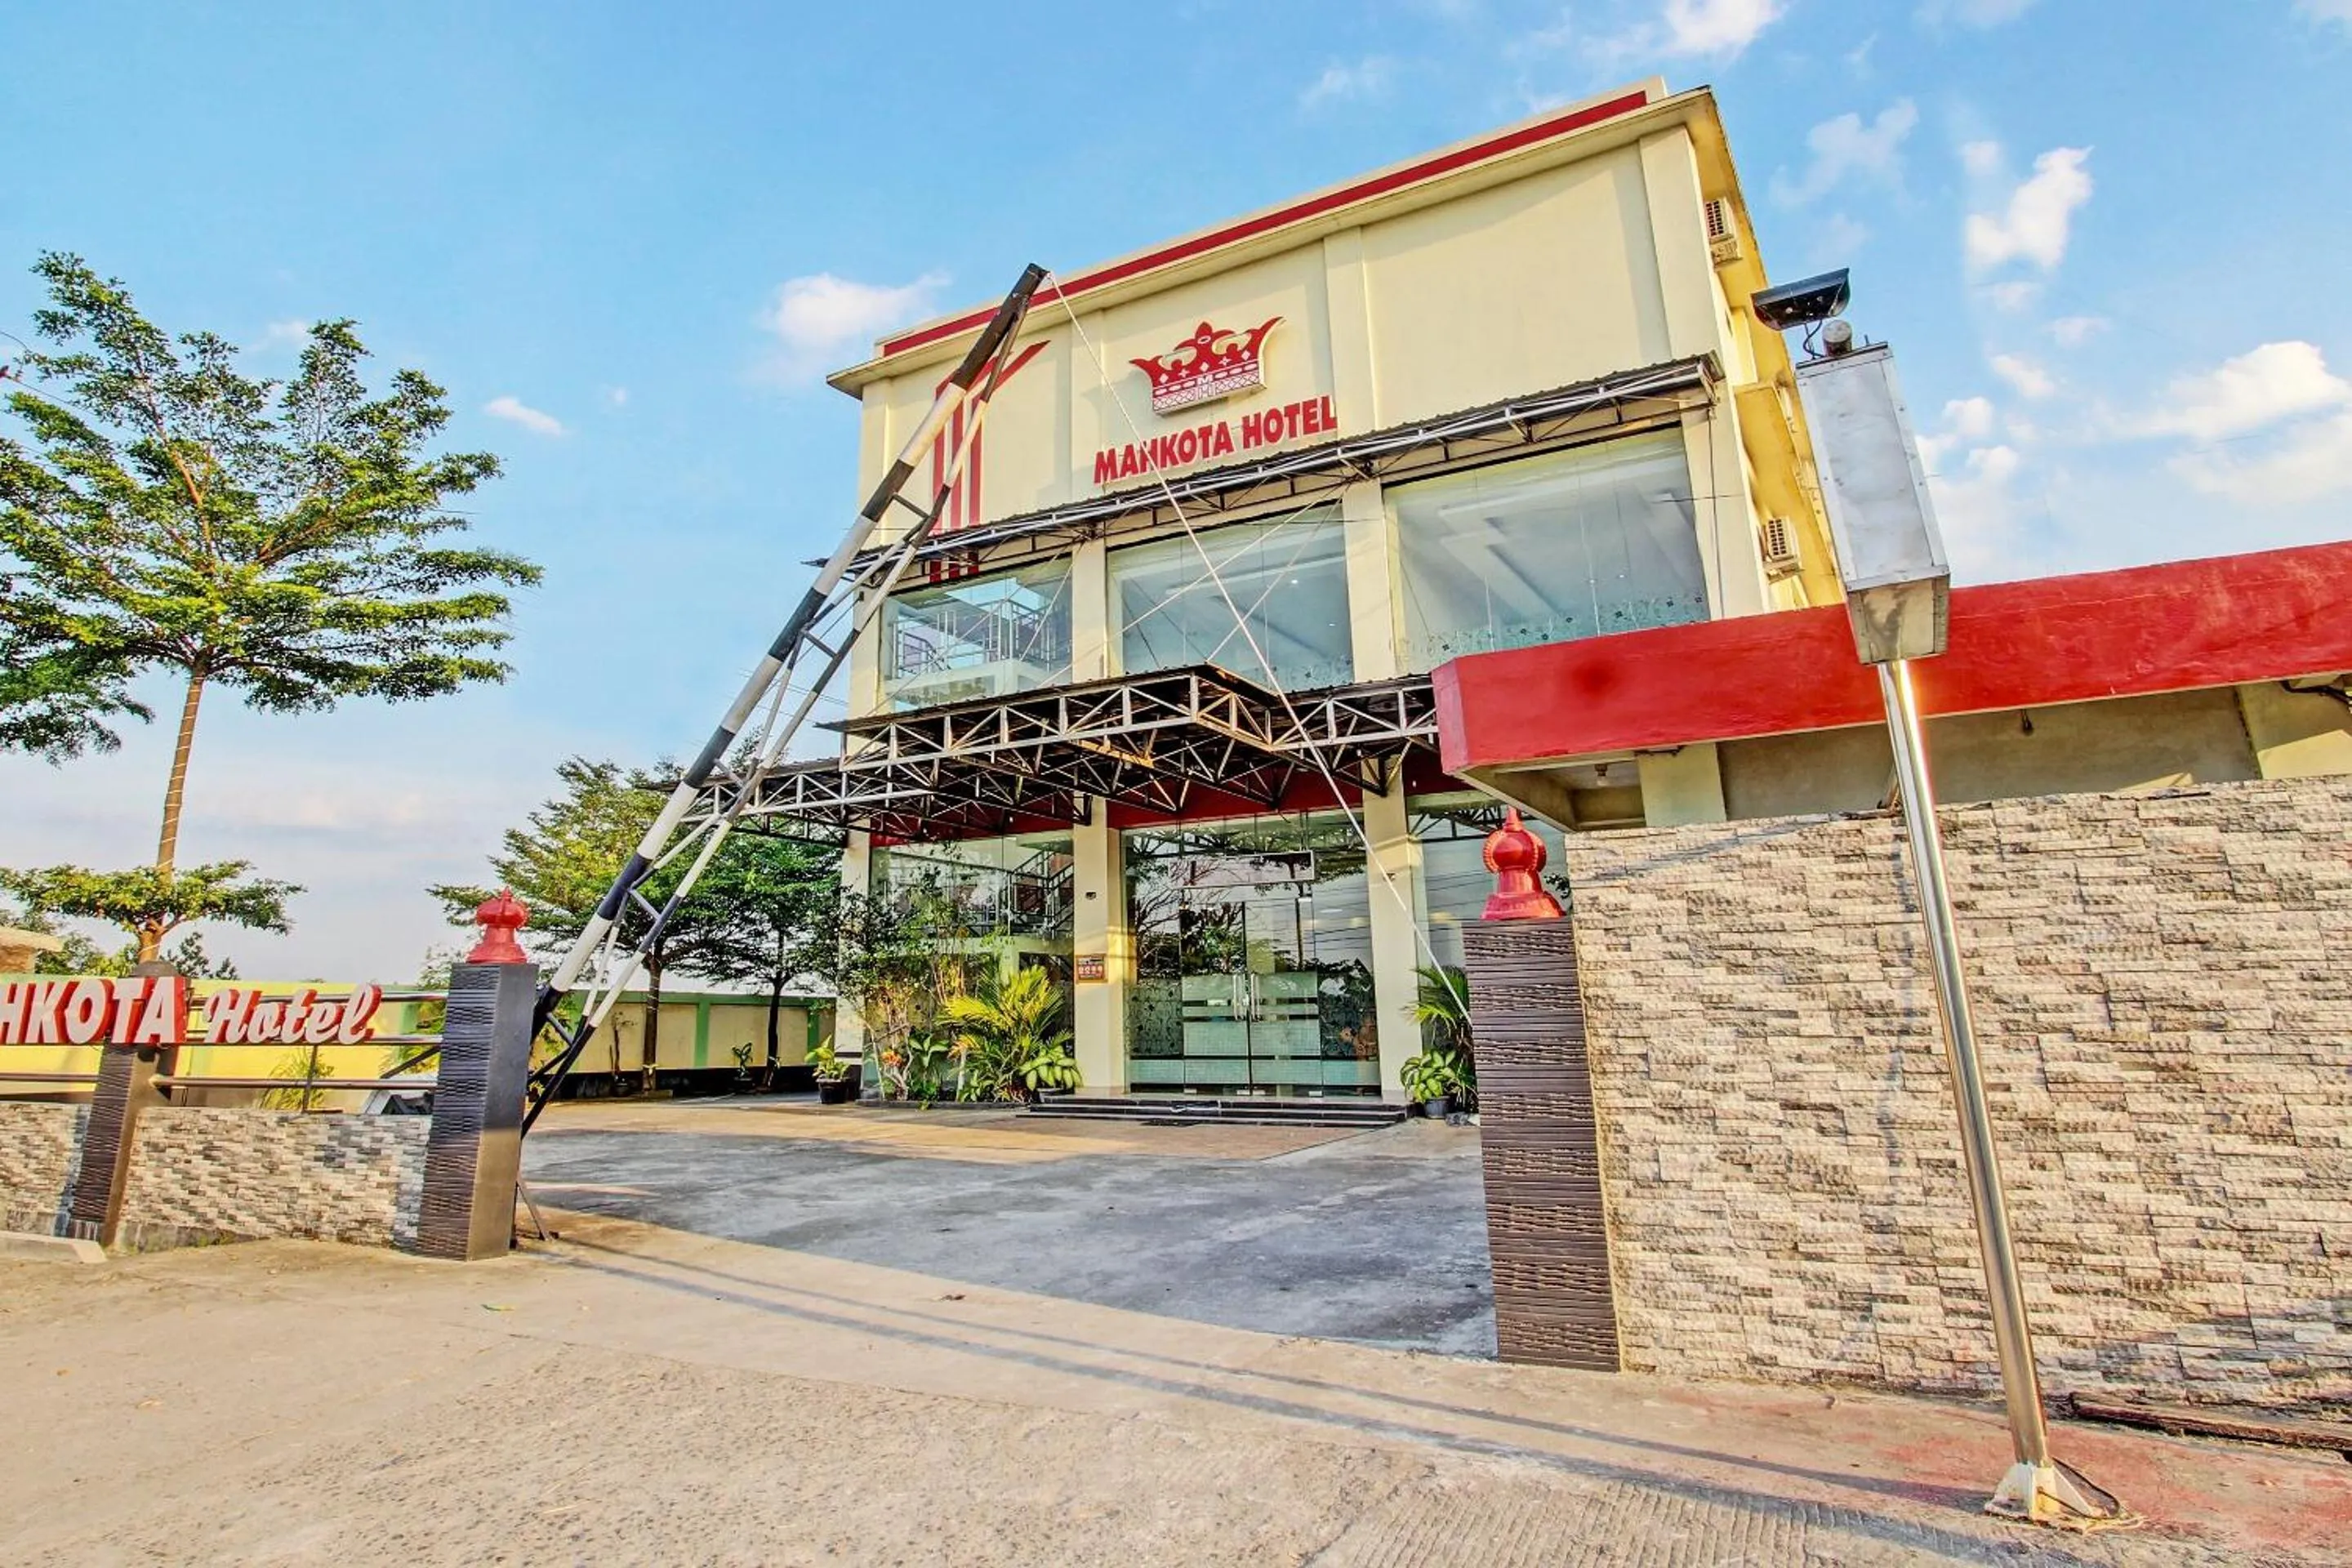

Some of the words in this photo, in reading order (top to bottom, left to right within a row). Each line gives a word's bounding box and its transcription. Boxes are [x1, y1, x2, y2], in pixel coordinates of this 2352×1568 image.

[1094, 421, 1235, 484] MAHKOTA
[1241, 394, 1338, 450] HOTEL
[203, 982, 379, 1045] Hotel
